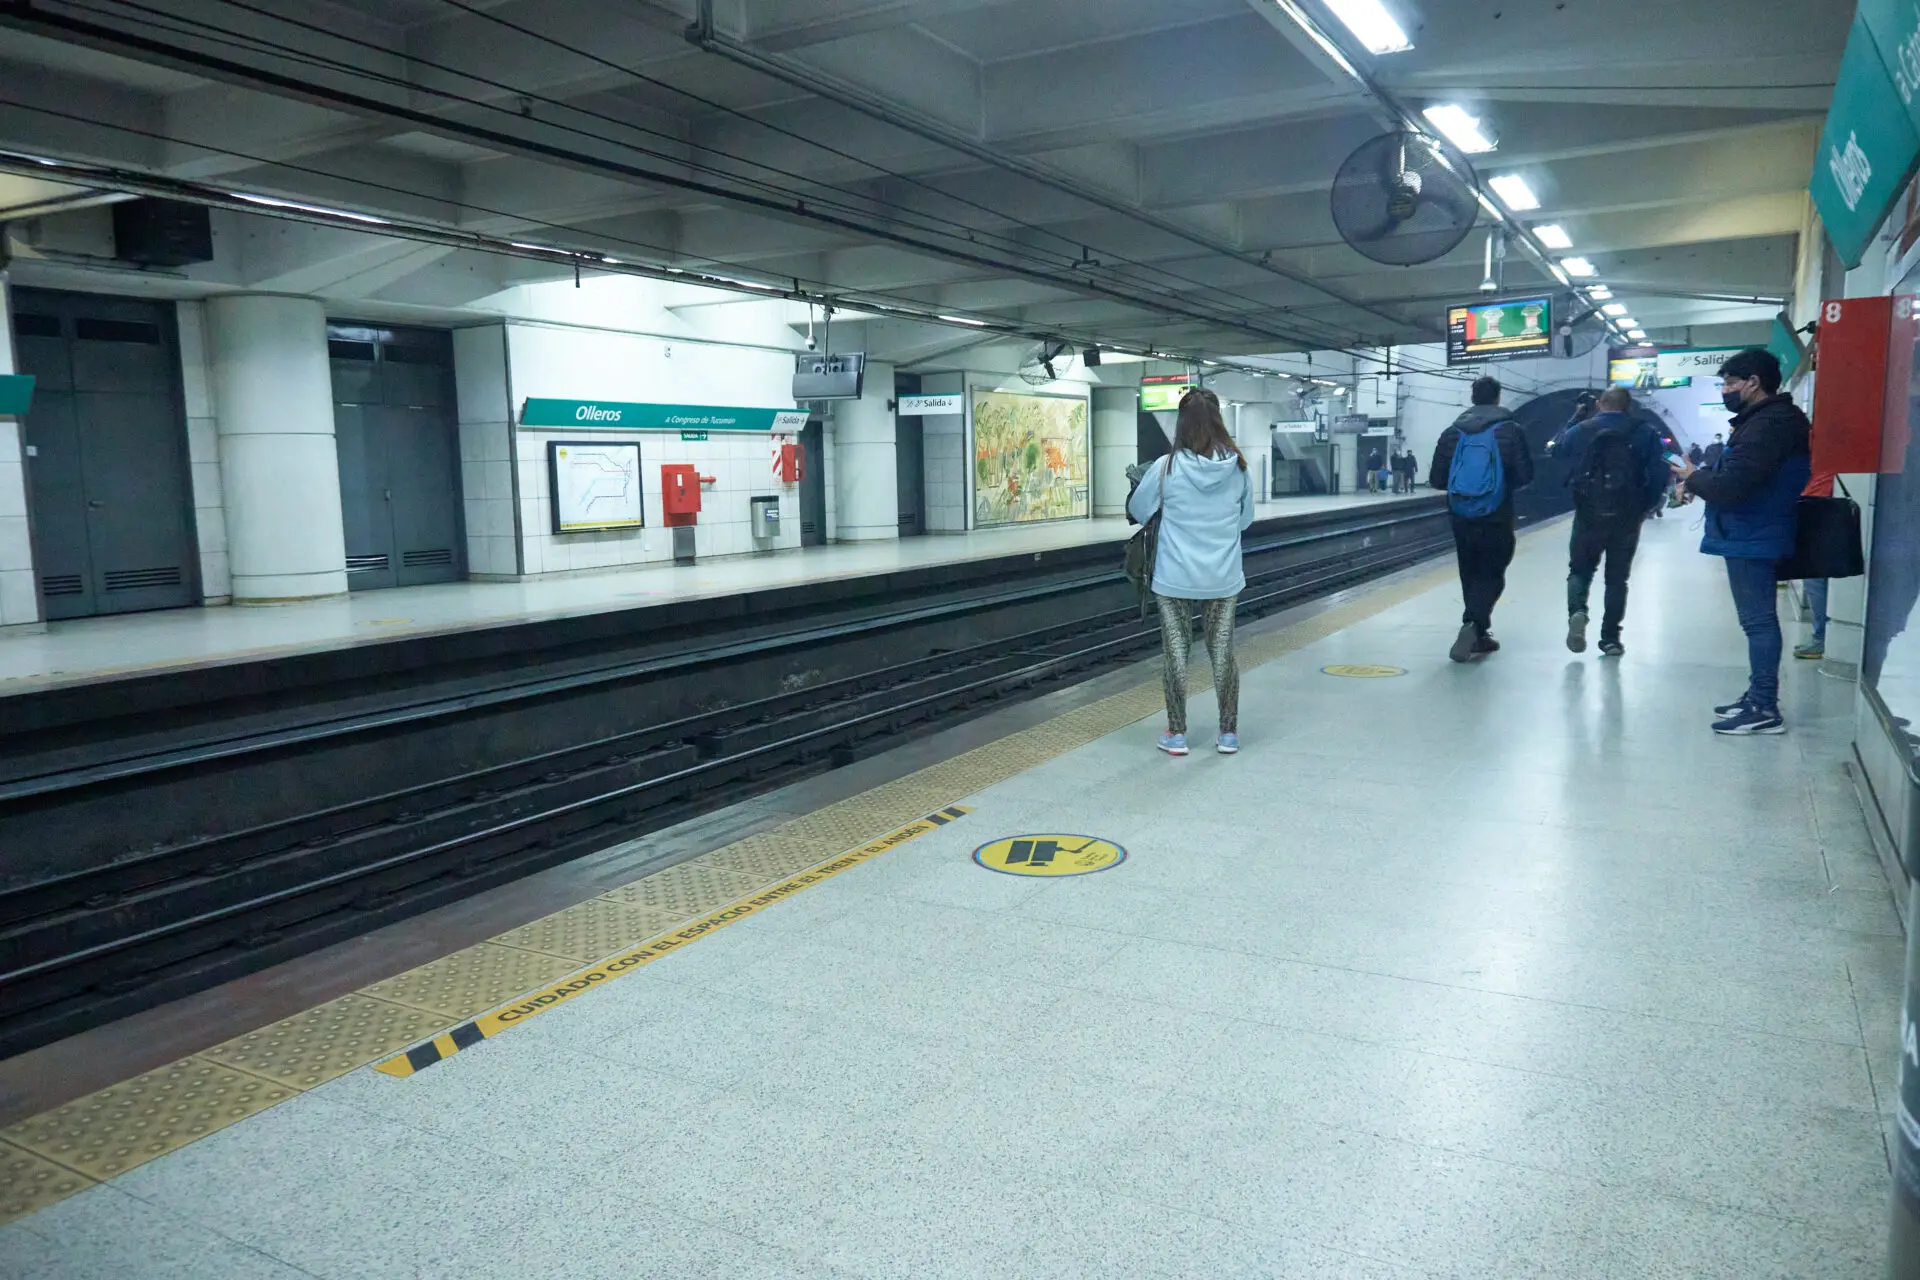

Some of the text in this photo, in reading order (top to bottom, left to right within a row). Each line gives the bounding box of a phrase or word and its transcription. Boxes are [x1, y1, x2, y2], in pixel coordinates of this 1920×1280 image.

[1826, 302, 1842, 323] 8
[924, 399, 946, 407] Salida
[576, 405, 622, 421] Olleros
[671, 415, 700, 425] Congreso
[700, 416, 709, 424] de
[782, 416, 800, 424] Salida
[498, 972, 607, 1022] CUIDADO
[606, 950, 655, 972] CON
[651, 938, 683, 951] EL
[676, 905, 753, 939] ESPACIO
[750, 882, 804, 906] ENTRE
[798, 875, 822, 884] EL
[816, 857, 859, 874] TREN
[864, 845, 886, 853] EL
